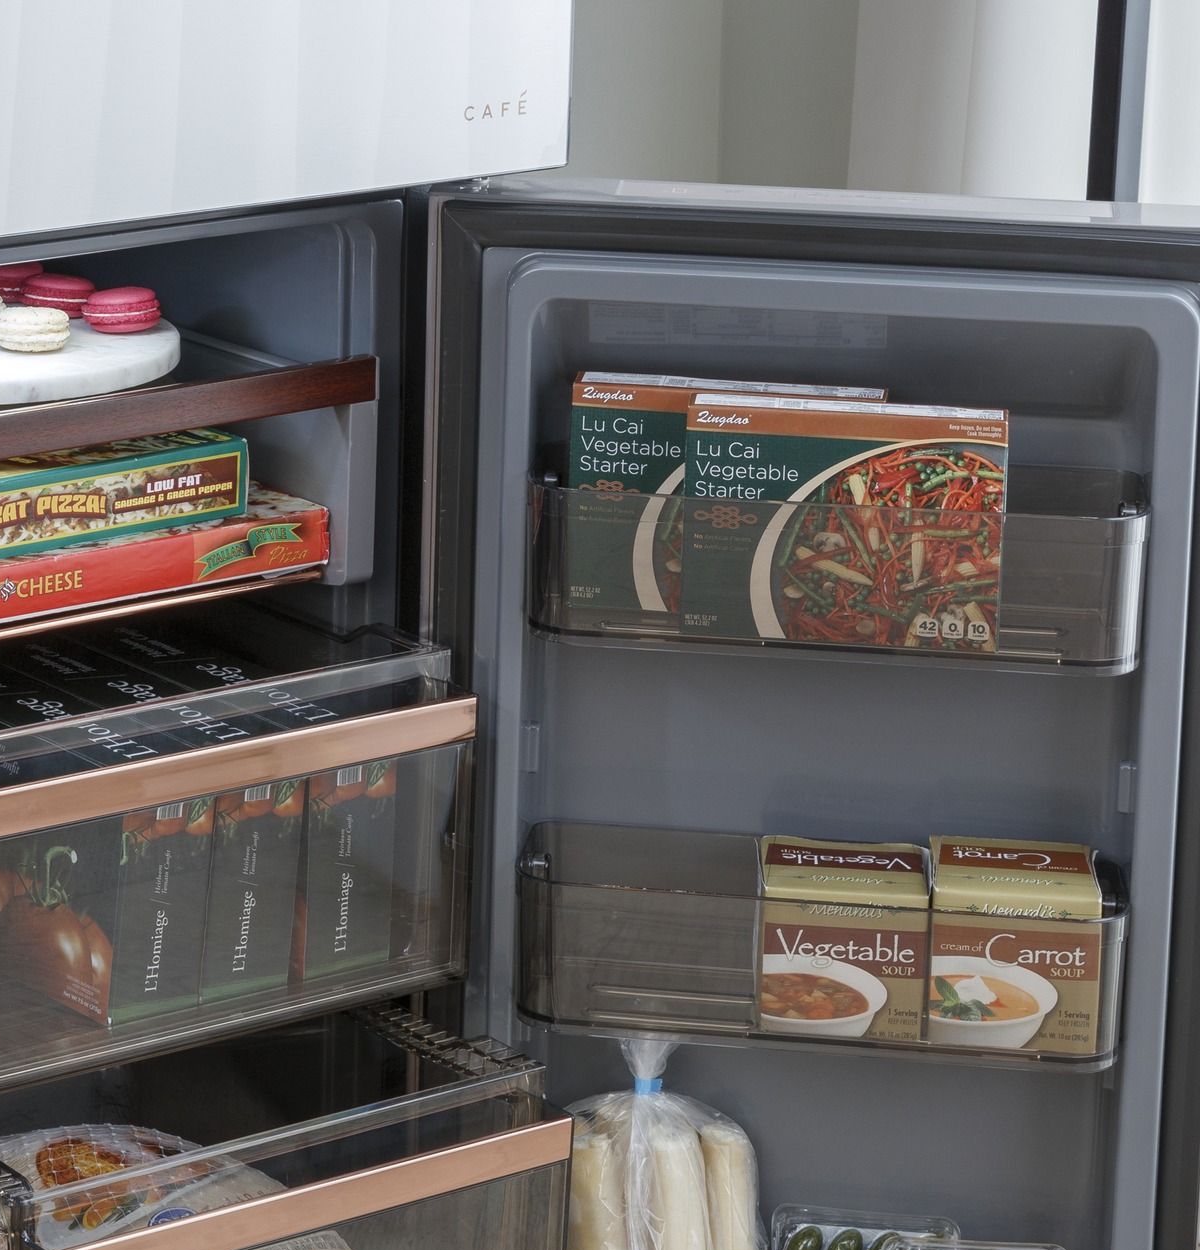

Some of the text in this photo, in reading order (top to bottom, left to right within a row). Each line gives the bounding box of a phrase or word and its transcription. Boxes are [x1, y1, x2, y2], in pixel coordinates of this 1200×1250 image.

[463, 88, 528, 121] CAFÉ
[581, 415, 644, 435] Lu Cai
[580, 435, 681, 458] Vegetable
[696, 440, 760, 459] Lu Cai
[579, 455, 649, 475] Starter
[695, 460, 799, 483] Vegetable
[147, 474, 203, 494] LOW FAT
[694, 480, 766, 500] Starter
[114, 495, 156, 510] SAUSAGE
[157, 494, 164, 502] &
[198, 481, 233, 495] PEPPER
[35, 493, 106, 521] PIZZA!
[206, 527, 287, 569] ITALIAN STYLE
[268, 546, 309, 566] Pizza
[16, 569, 84, 599] CHEESE
[919, 621, 936, 631] 42
[782, 853, 912, 870] Vegetable
[952, 850, 1052, 867] Carrot
[334, 872, 354, 954] L'Homiage
[232, 890, 257, 973] L'Homiage
[144, 909, 169, 993] L'Homiage
[776, 928, 915, 968] Vegetable
[940, 934, 1086, 968] cream of Carrot
[881, 965, 915, 976] SOUP
[1050, 967, 1085, 978] SOUP
[894, 1009, 918, 1019] Serving
[1064, 1011, 1090, 1020] Serving
